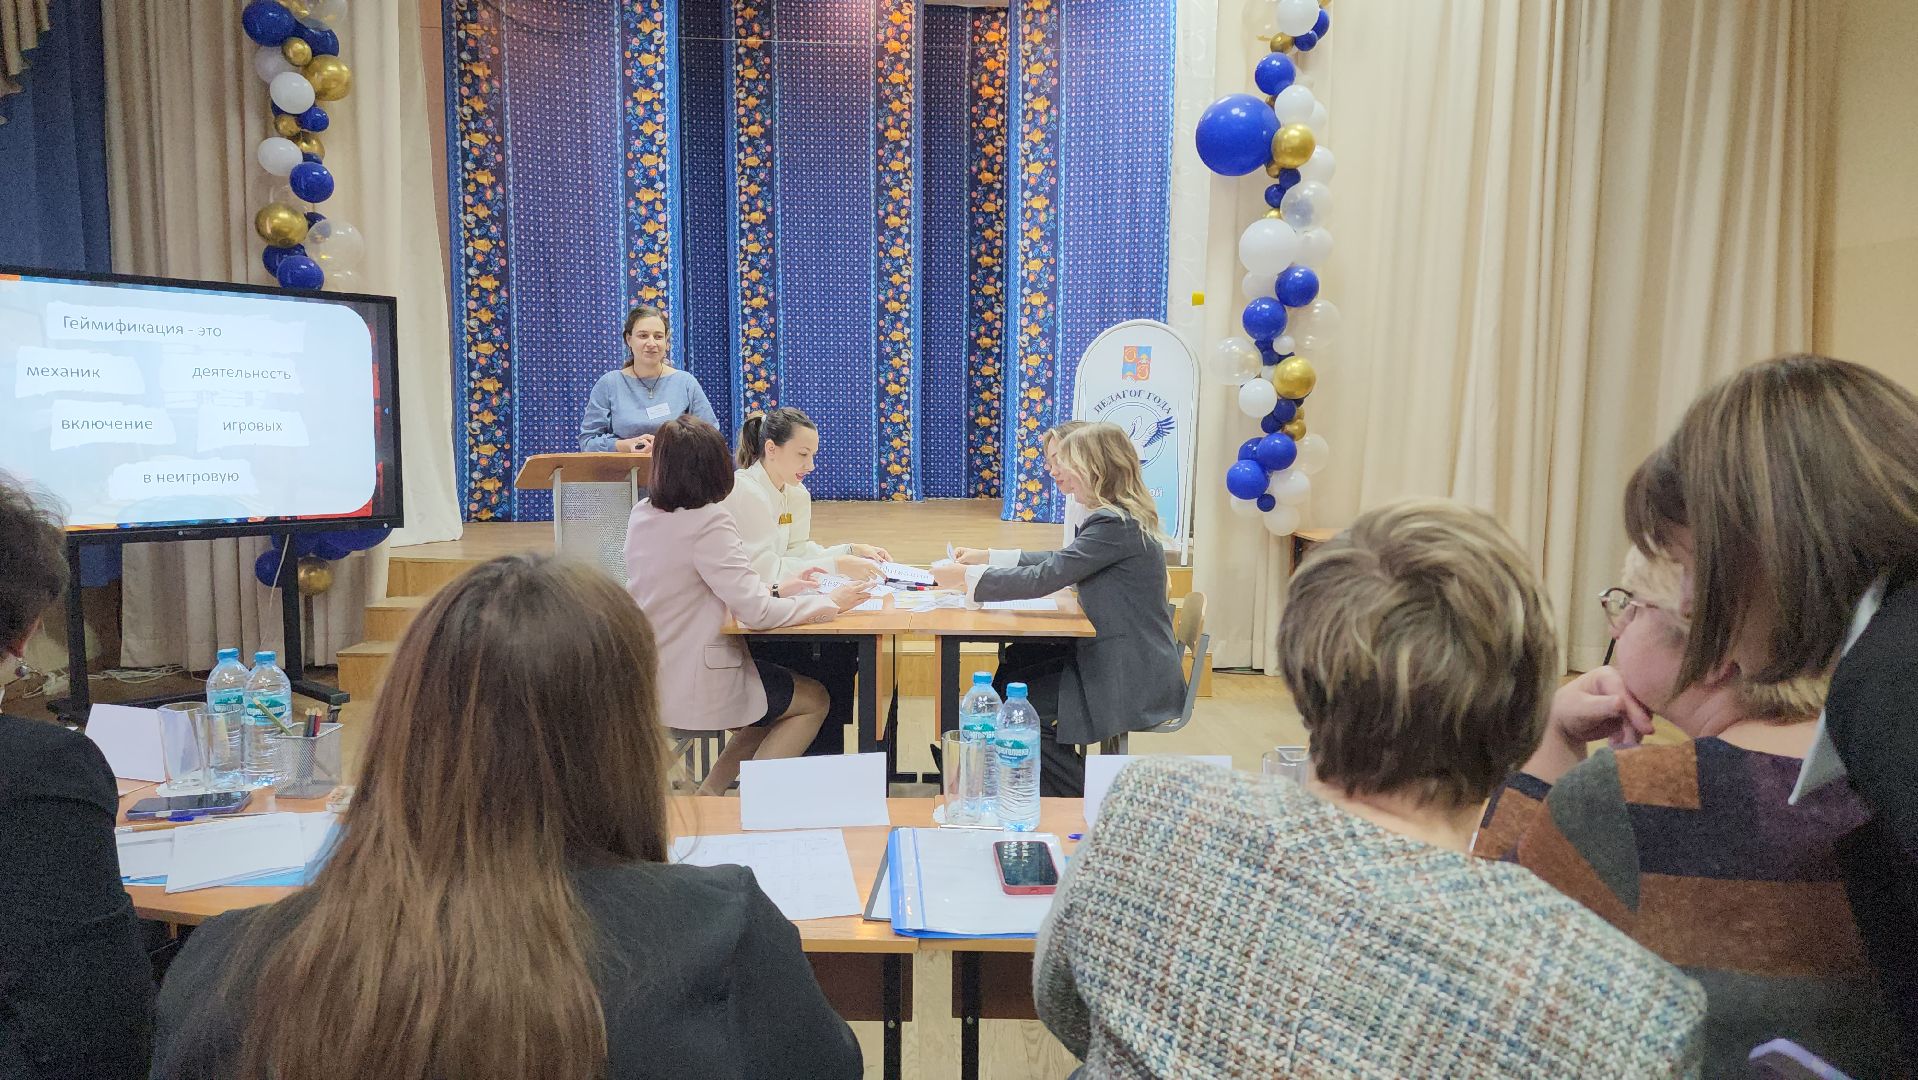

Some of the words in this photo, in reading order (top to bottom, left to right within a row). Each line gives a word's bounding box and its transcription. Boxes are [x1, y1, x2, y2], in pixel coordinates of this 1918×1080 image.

[63, 315, 184, 337] Геймификация
[198, 326, 222, 337] это
[26, 366, 101, 379] механик
[192, 367, 292, 380] деятельность
[1093, 389, 1146, 415] ПЕДАГОГ
[1146, 392, 1172, 415] ГОДА
[61, 418, 154, 431] включение
[222, 420, 284, 435] игровых
[143, 473, 152, 484] в
[156, 472, 240, 486] неигровую
